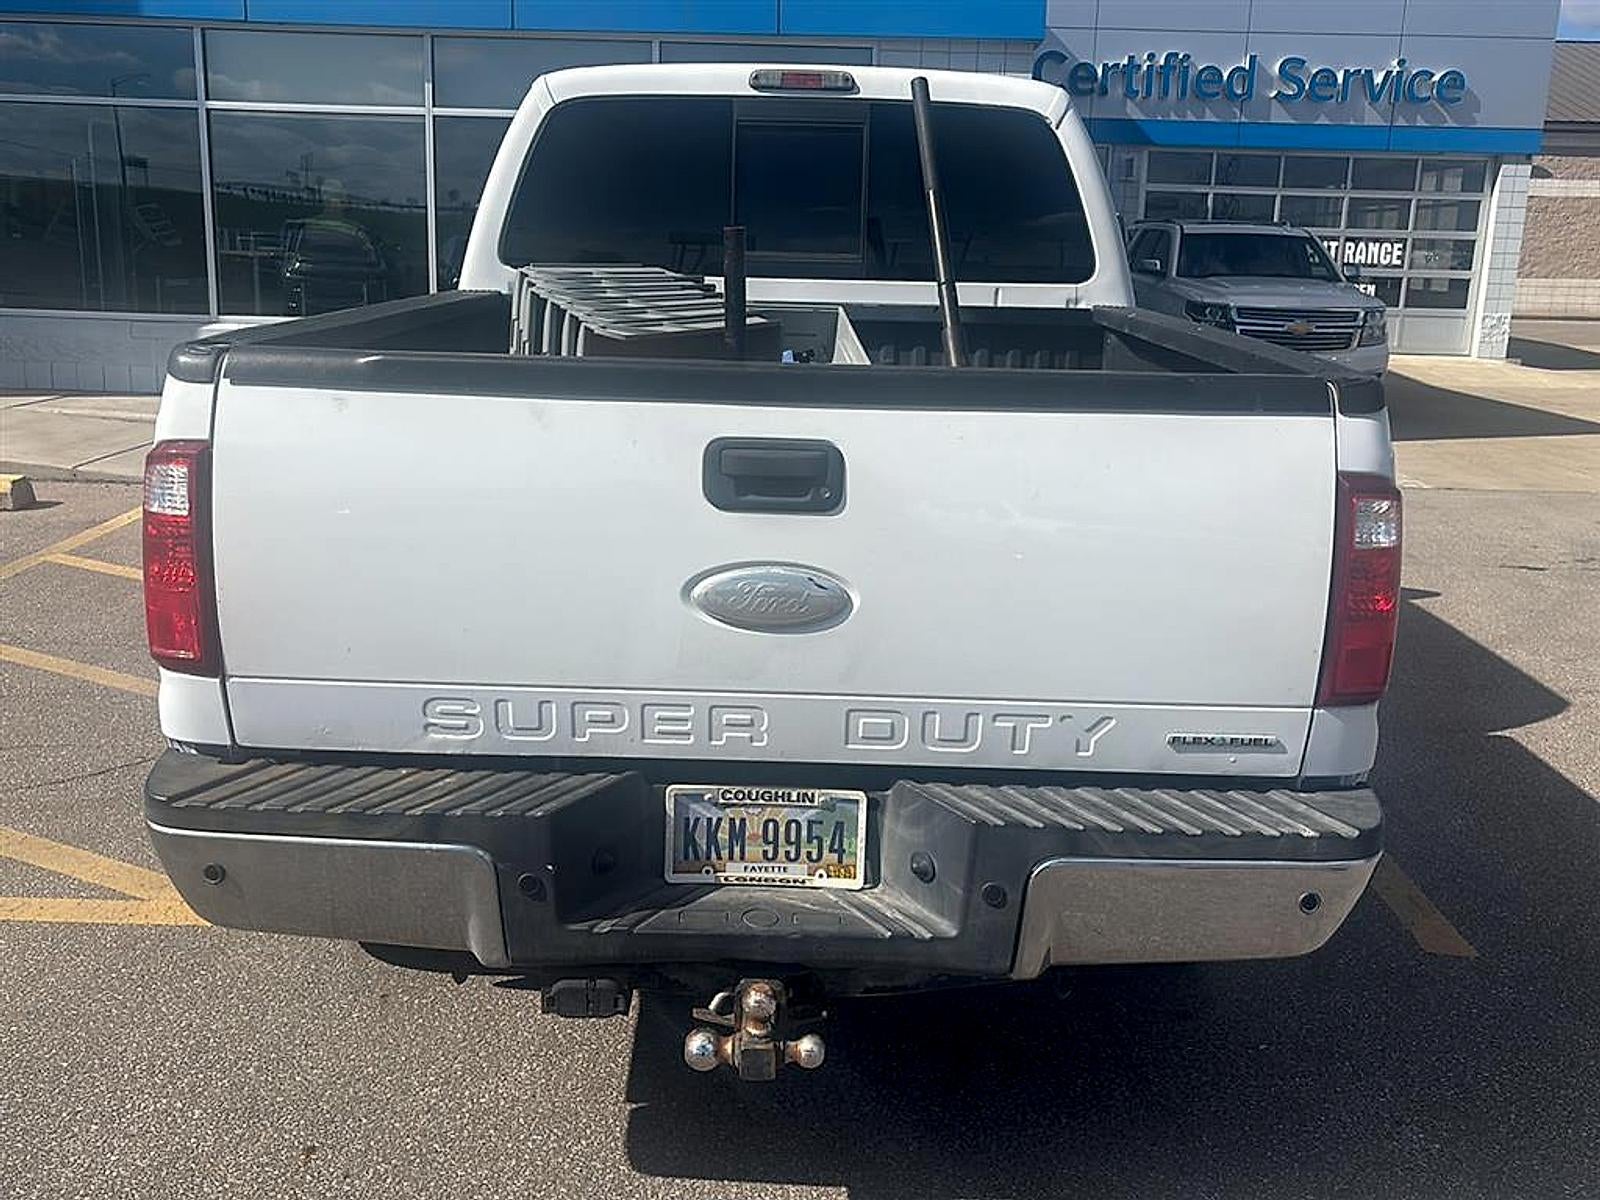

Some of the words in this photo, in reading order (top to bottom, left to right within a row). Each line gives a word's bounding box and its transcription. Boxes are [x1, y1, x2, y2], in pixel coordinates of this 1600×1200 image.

[1032, 50, 1258, 101] Certified
[1272, 56, 1466, 102] Service
[727, 580, 812, 614] Ford
[422, 697, 769, 747] SUPER
[845, 708, 1118, 758] DUTY
[1229, 738, 1275, 747] FUEL
[720, 789, 816, 804] COUGHLIN
[683, 815, 748, 861] KKM
[761, 817, 847, 864] 9954
[743, 864, 789, 874] FAYETTE
